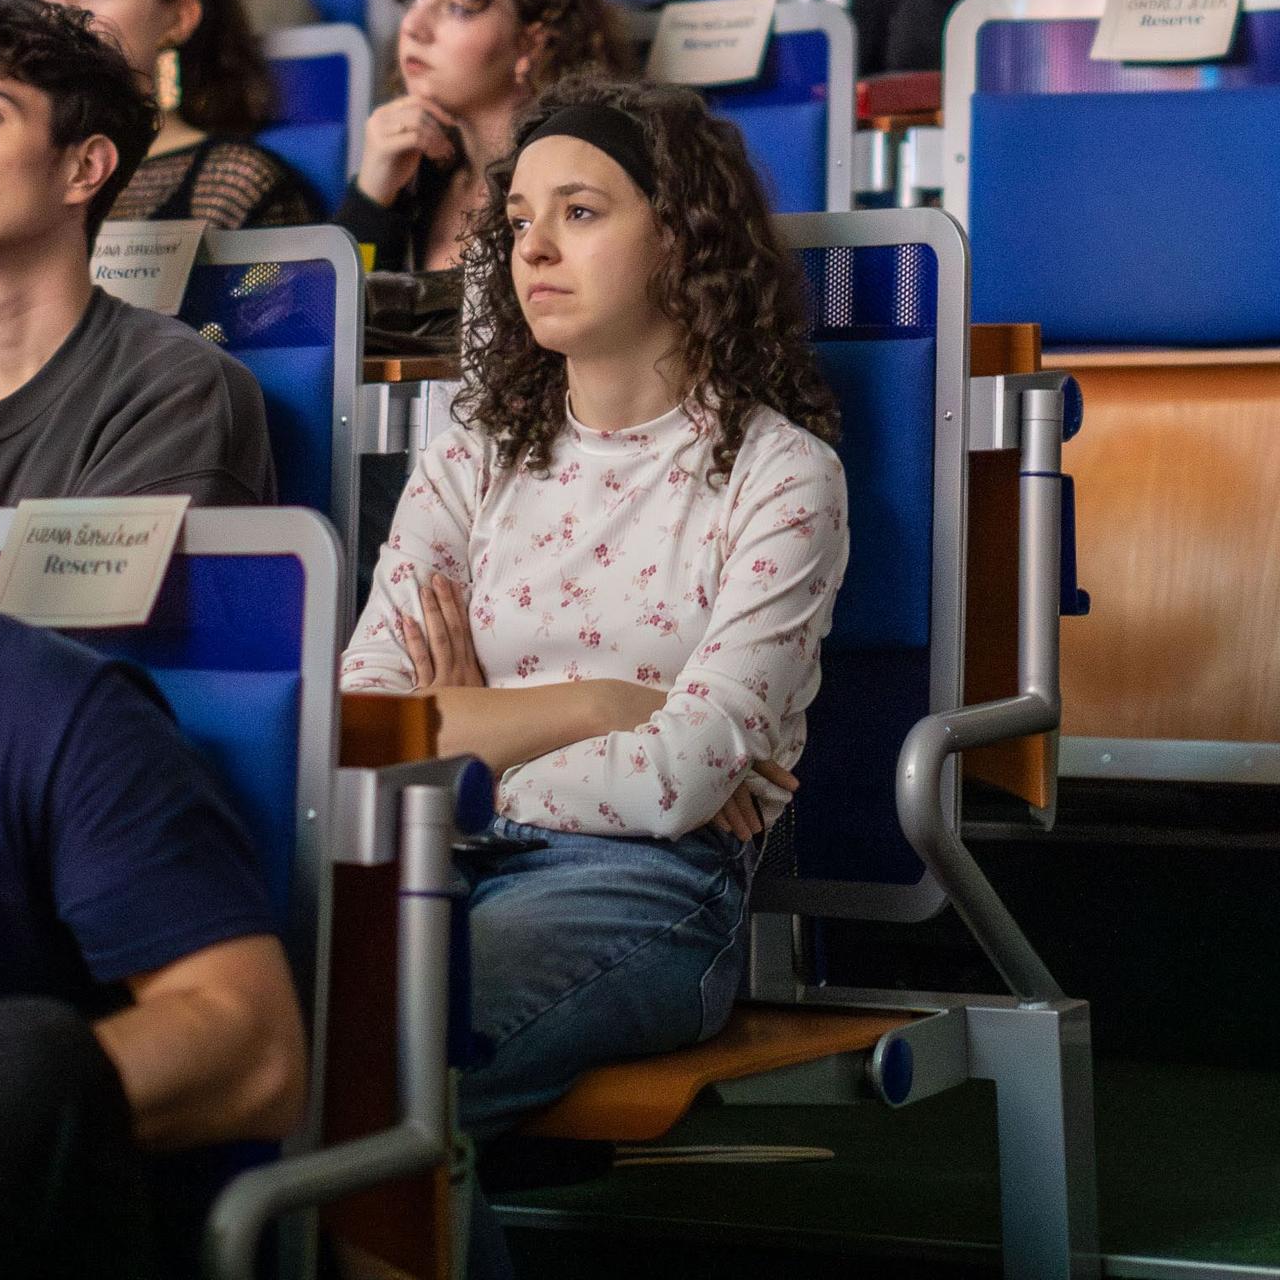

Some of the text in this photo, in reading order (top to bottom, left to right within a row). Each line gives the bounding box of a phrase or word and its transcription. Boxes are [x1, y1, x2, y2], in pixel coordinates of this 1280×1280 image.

[1139, 14, 1205, 27] Reserve
[96, 264, 161, 280] Reserve
[43, 553, 128, 575] Reserve
